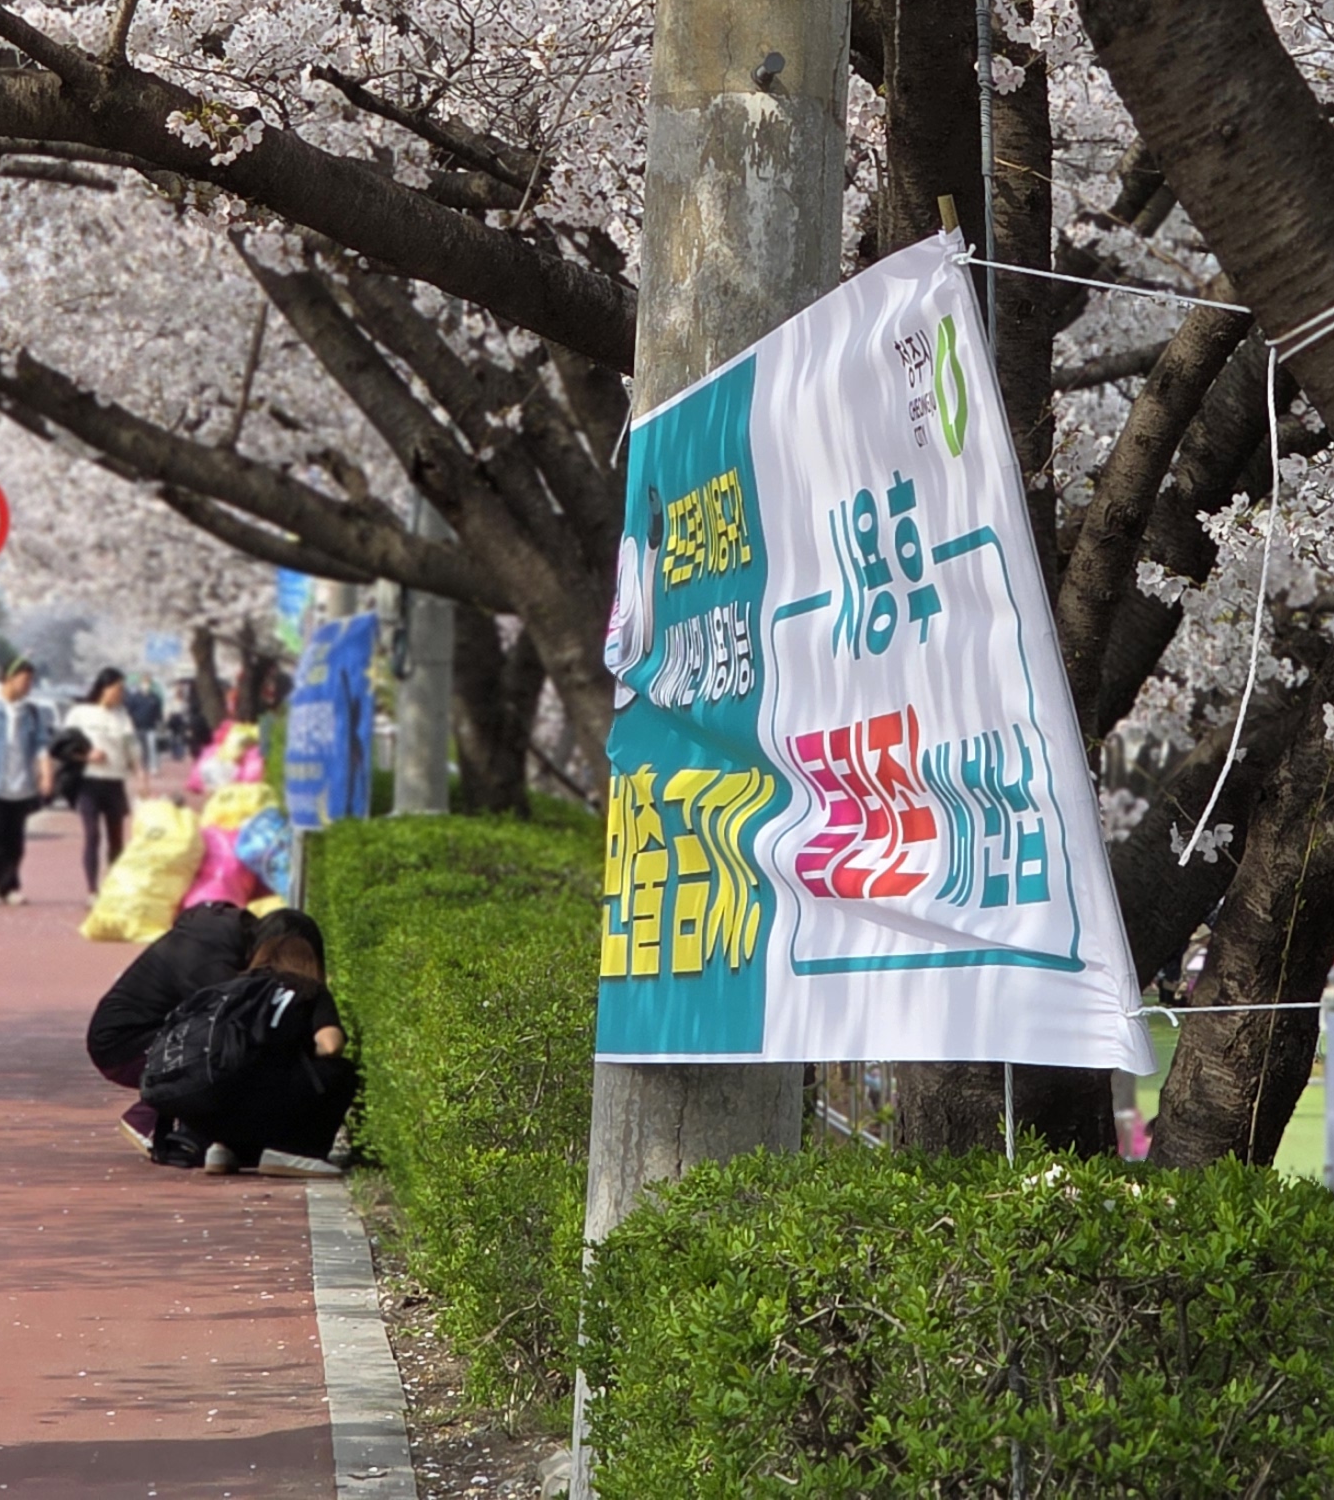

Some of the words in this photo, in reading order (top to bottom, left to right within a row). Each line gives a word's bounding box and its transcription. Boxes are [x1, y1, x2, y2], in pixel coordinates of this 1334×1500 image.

[893, 329, 934, 389] 청주시
[663, 487, 705, 592] 푸드트럭
[703, 466, 751, 574] 이용구간
[697, 601, 755, 701] 사용가능!
[600, 764, 668, 977] 반출
[663, 767, 775, 973] 금지!
